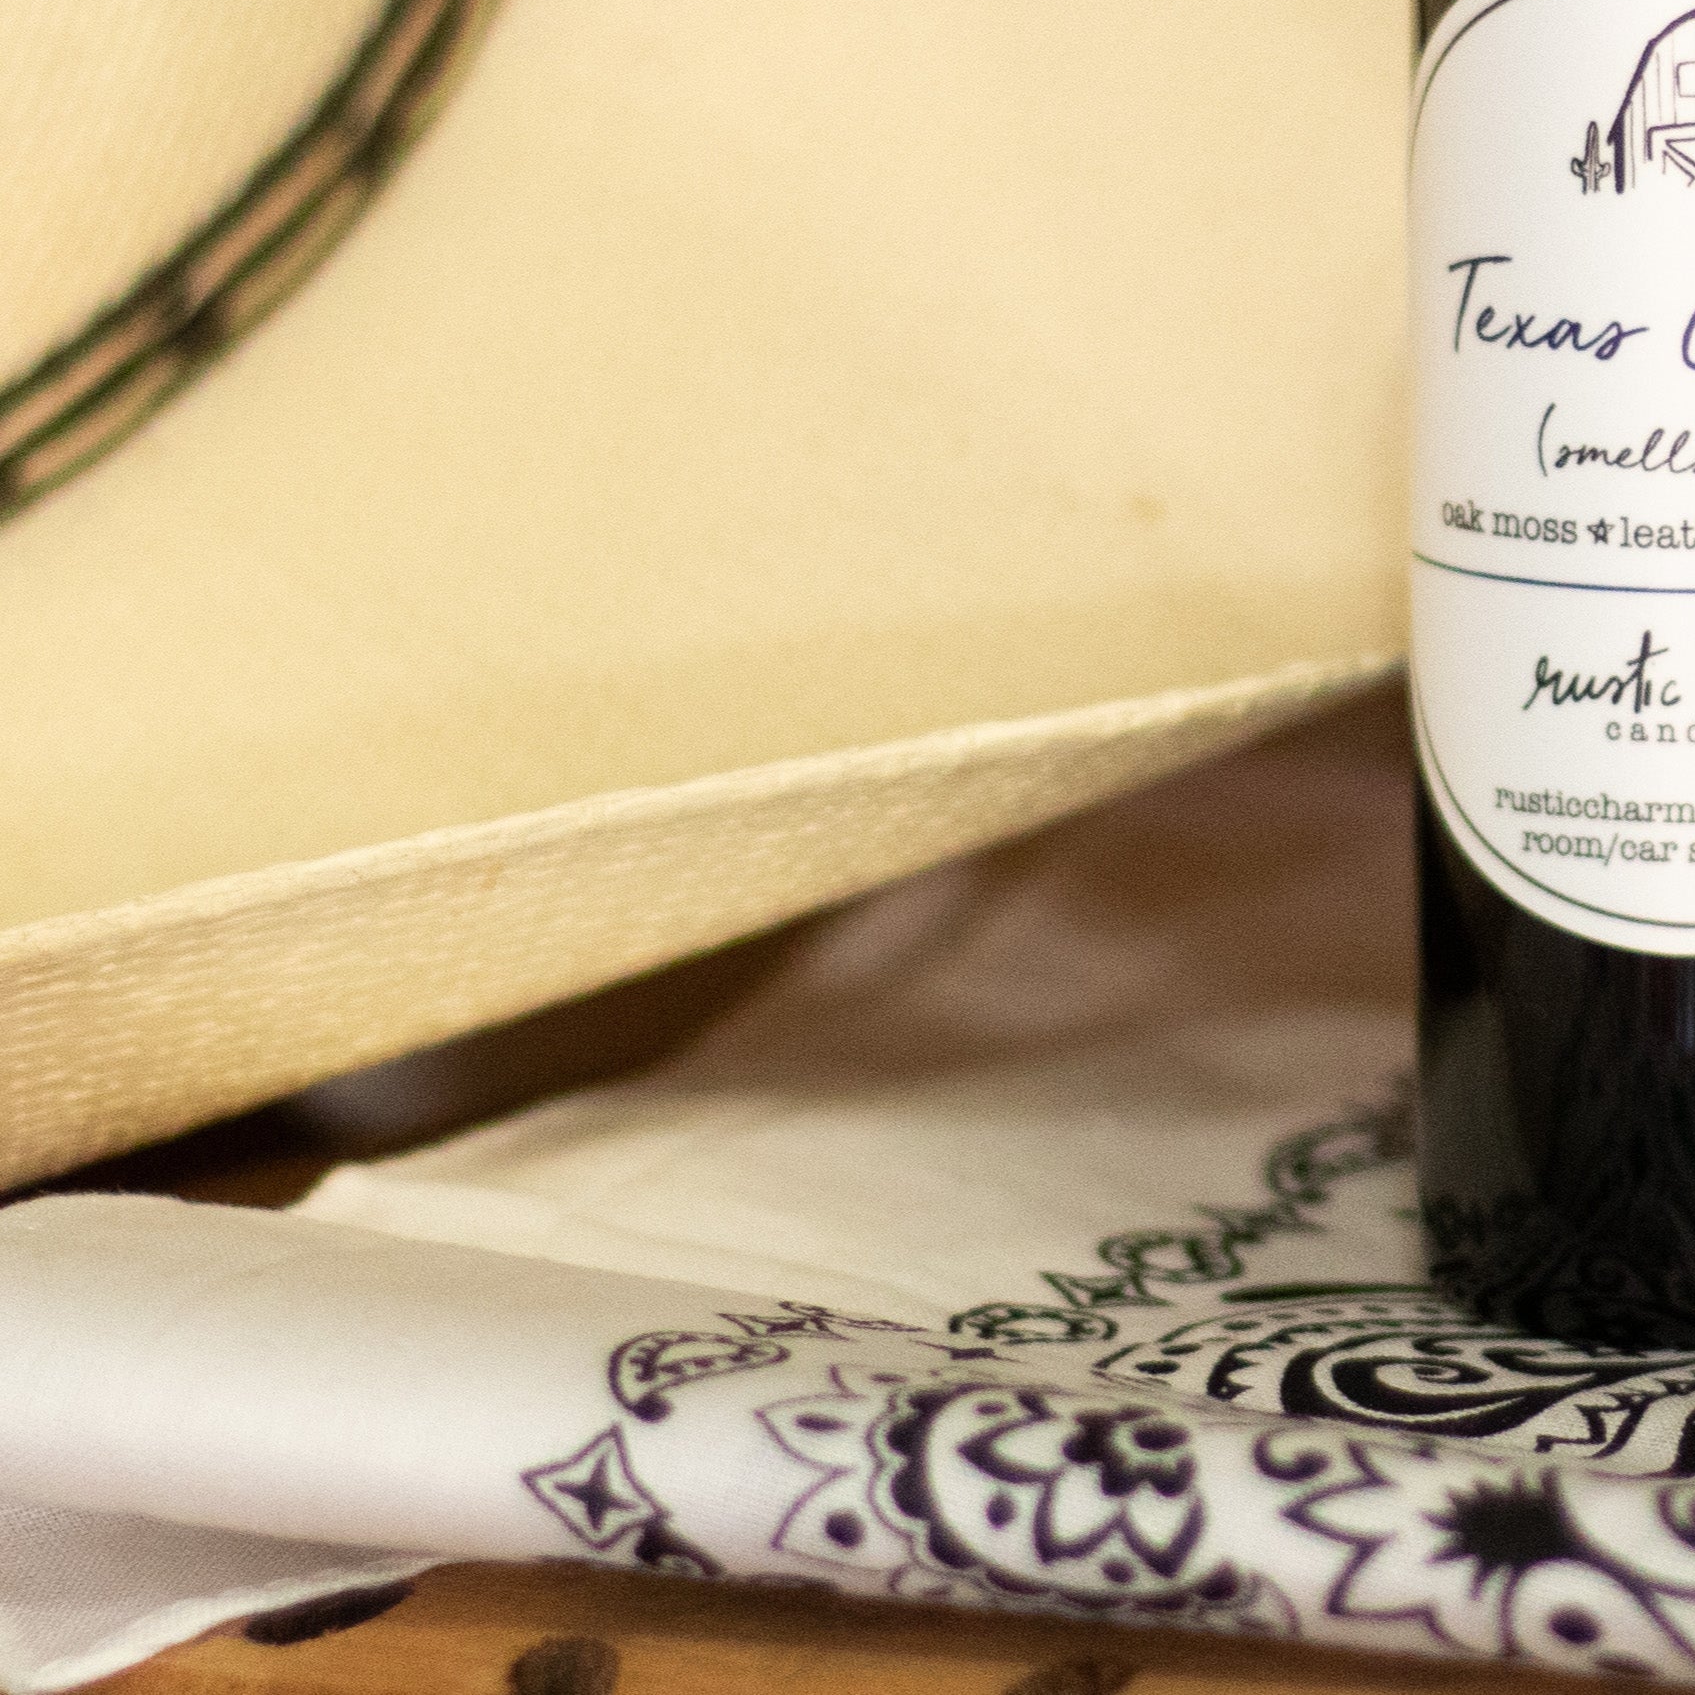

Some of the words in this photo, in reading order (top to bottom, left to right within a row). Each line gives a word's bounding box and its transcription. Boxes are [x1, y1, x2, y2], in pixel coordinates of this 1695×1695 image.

[1447, 254, 1650, 362] Texas
[1442, 499, 1485, 535] oak
[1491, 510, 1579, 546] moss
[1521, 629, 1682, 715] rustic
[1522, 831, 1679, 867] room/car
